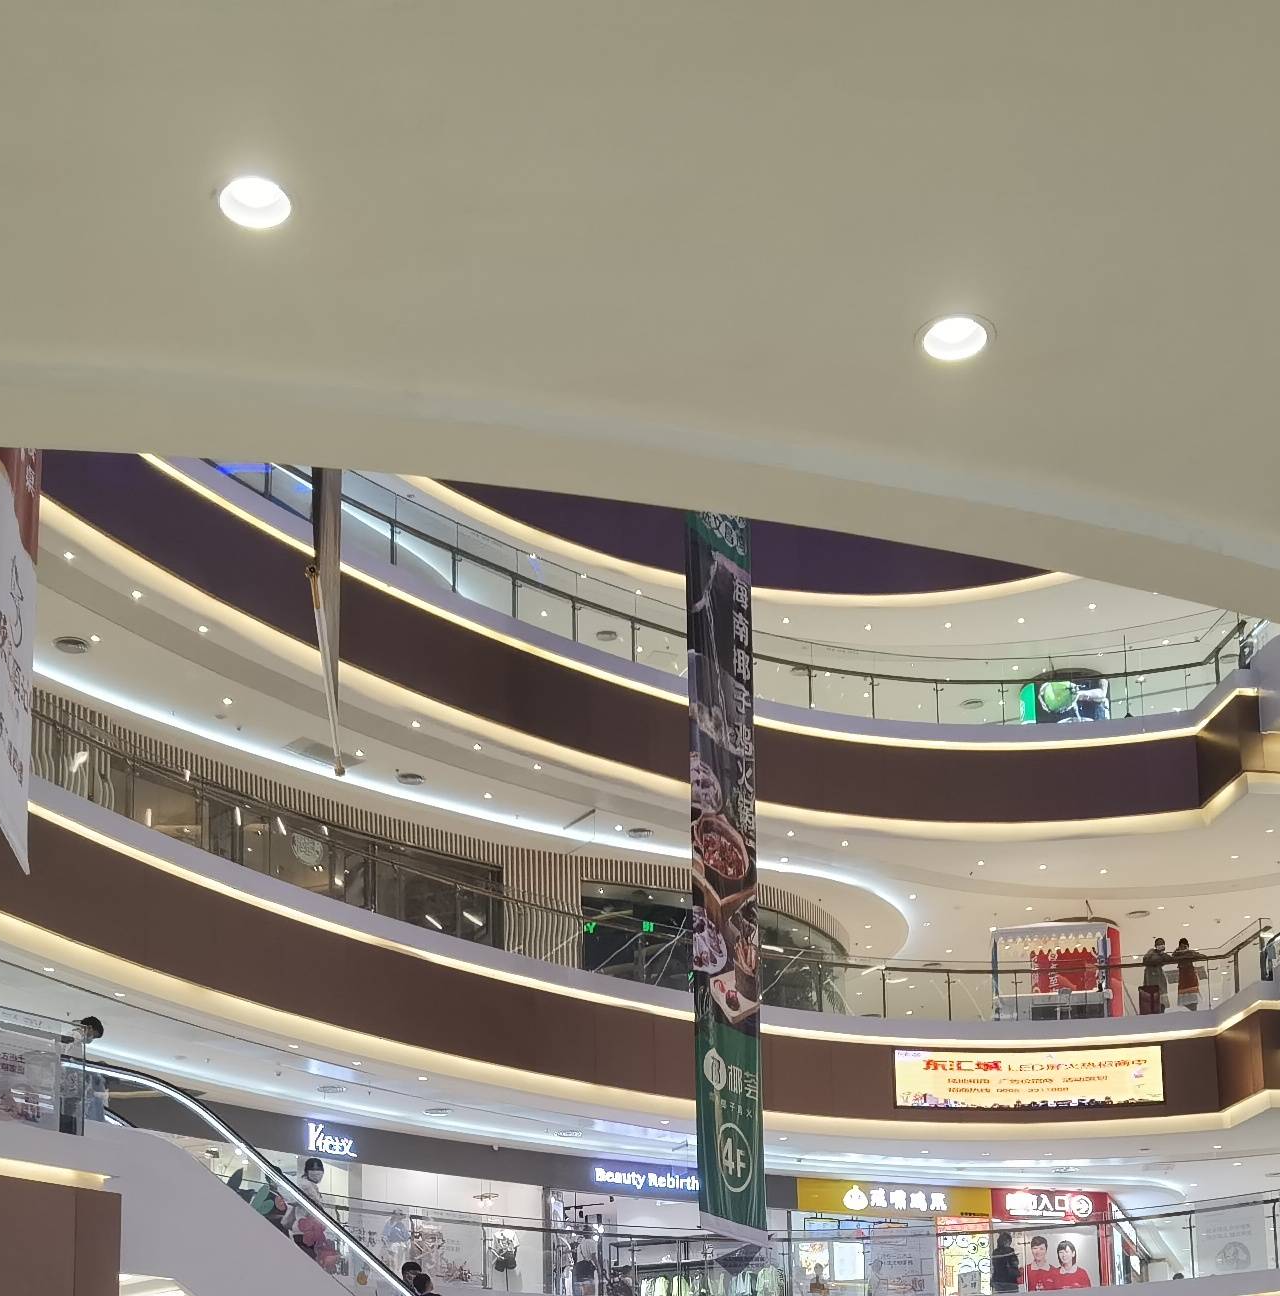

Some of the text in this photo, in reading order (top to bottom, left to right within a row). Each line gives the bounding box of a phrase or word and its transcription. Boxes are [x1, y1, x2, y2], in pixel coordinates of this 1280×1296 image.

[722, 1137, 747, 1178] 4F
[595, 1167, 700, 1191] Beauty Rebirth
